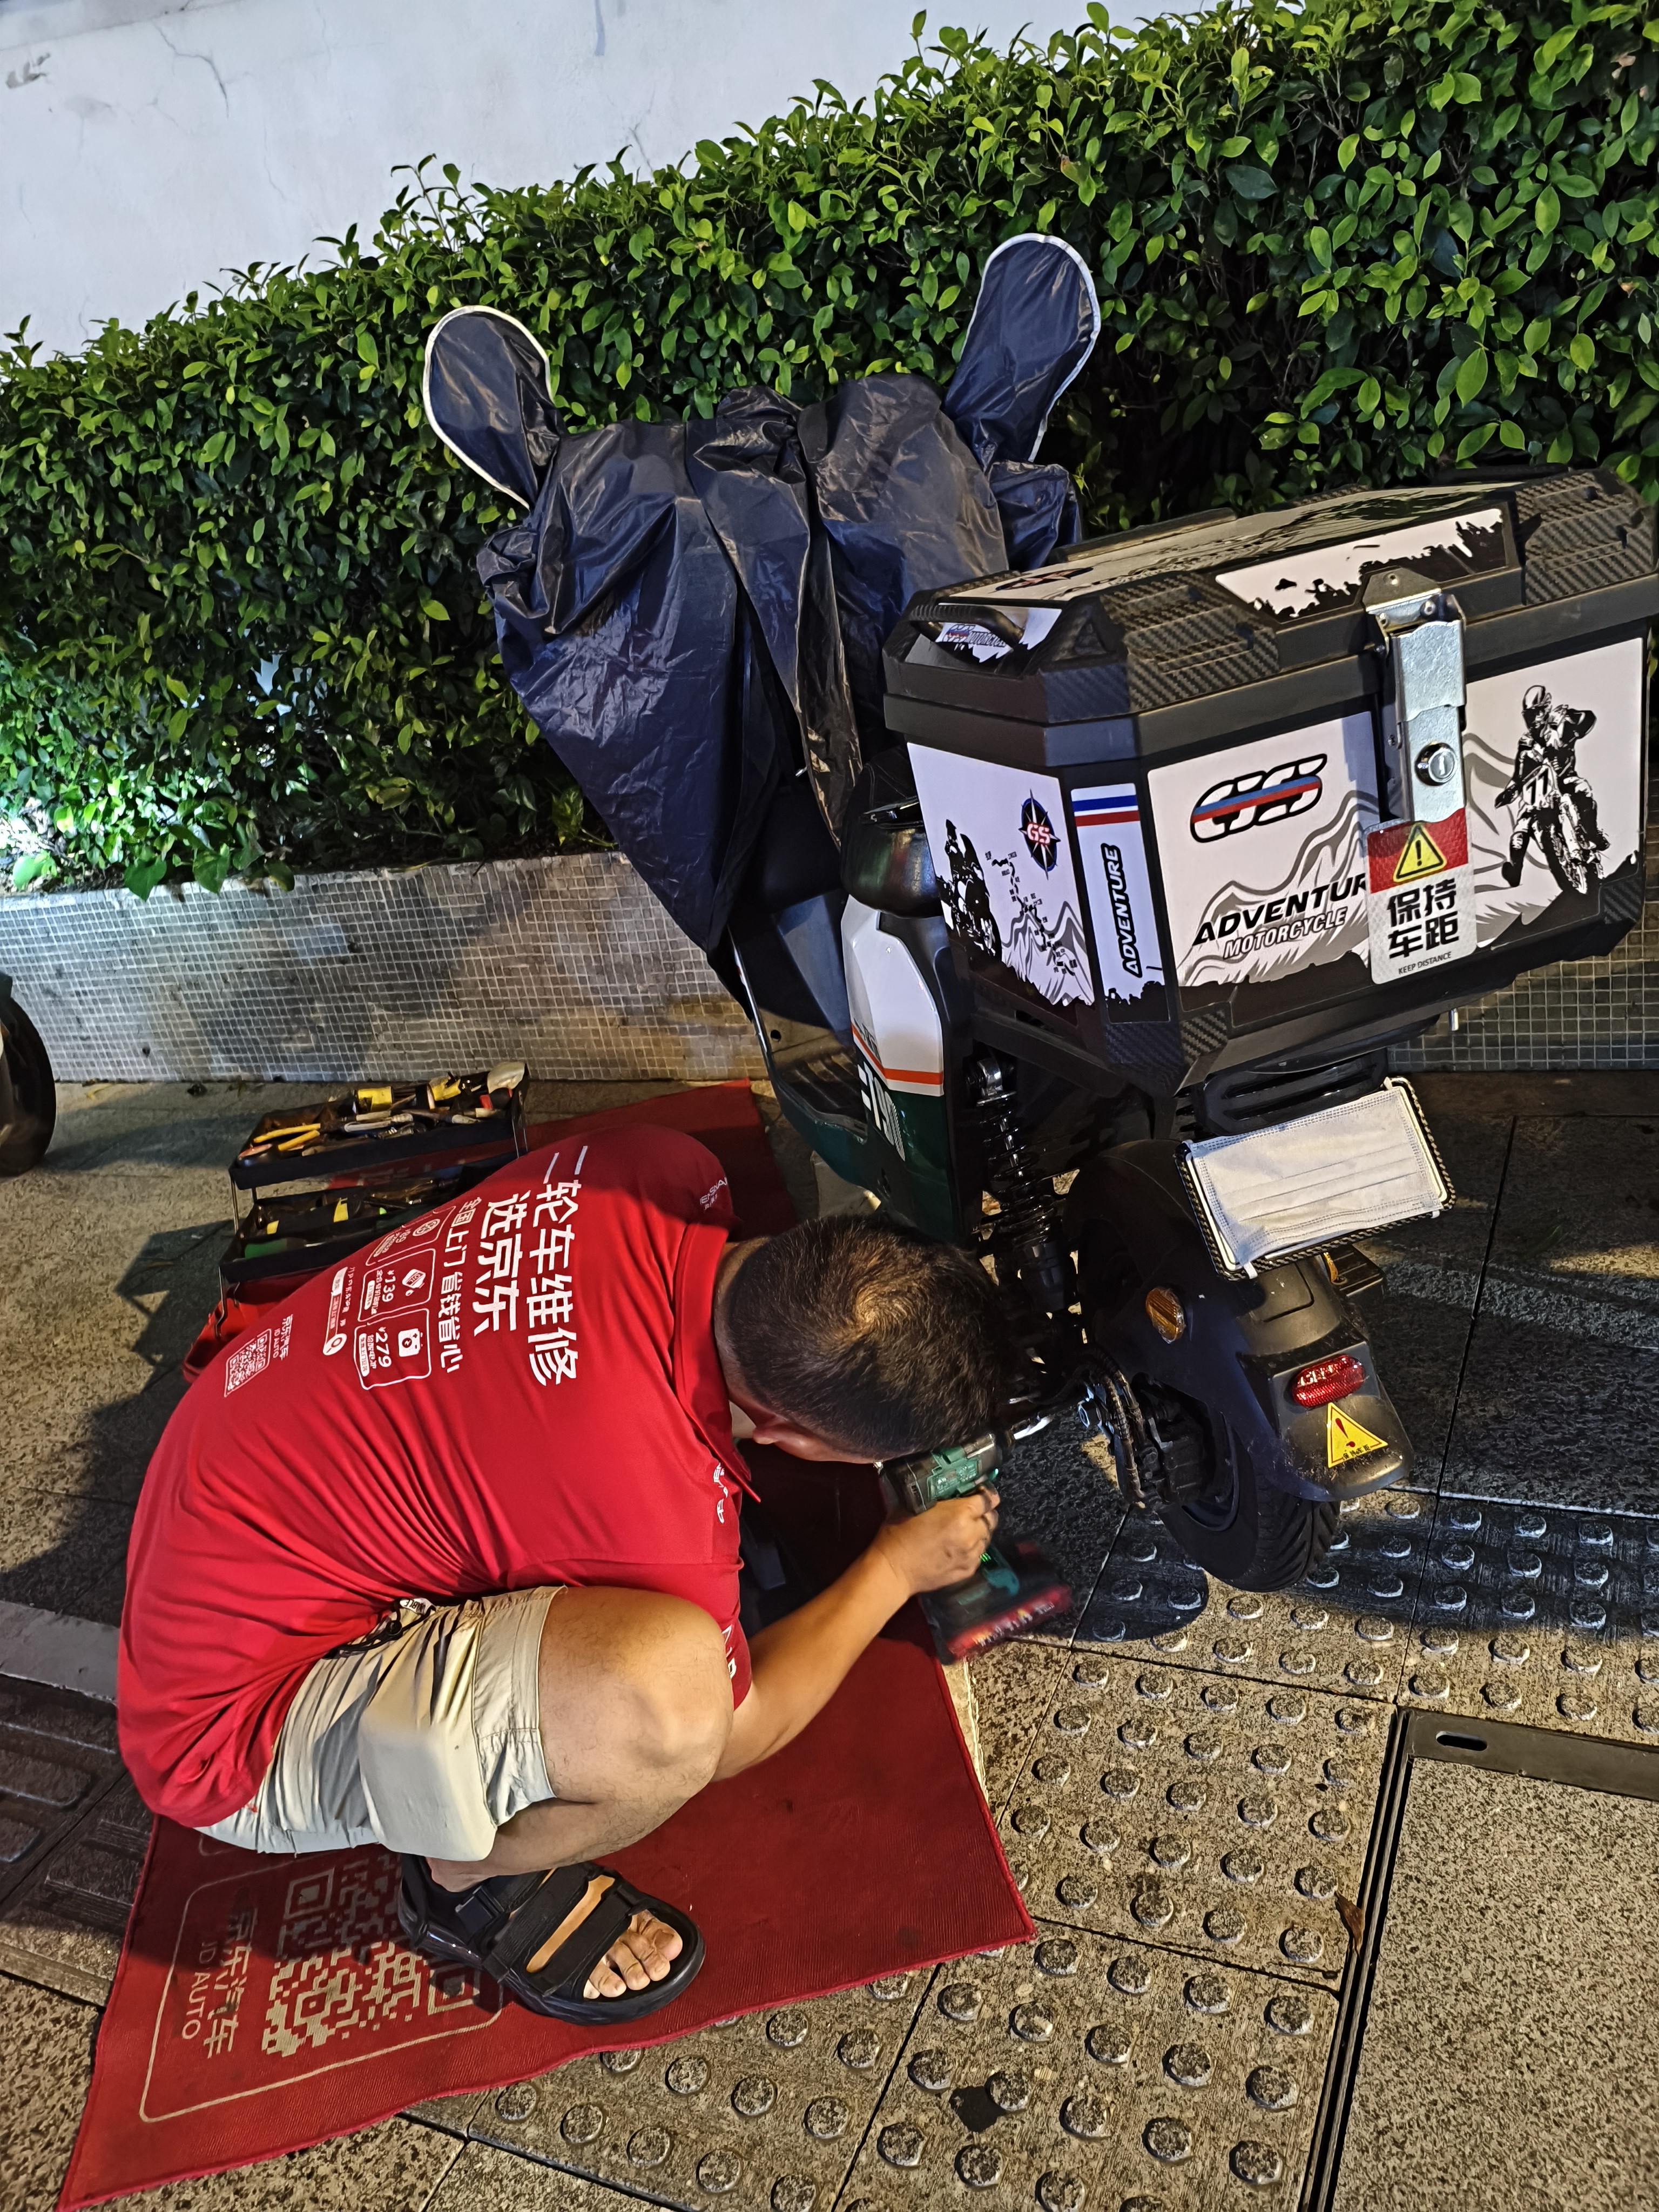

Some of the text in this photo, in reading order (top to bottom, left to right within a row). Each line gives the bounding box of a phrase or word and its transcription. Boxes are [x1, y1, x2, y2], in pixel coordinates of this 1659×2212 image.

[1027, 820, 1051, 846] GS
[1101, 843, 1143, 977] ADVENTURE
[1192, 872, 1366, 946] ADVENTUR
[1387, 878, 1457, 927] 保持
[1223, 906, 1348, 960] MOTORCYCLE
[1387, 911, 1460, 960] 车距
[1398, 951, 1452, 975] KEEP DISTANCE
[382, 1270, 396, 1302] ¥139
[437, 1197, 482, 1373] 全国上门 省钱省心
[472, 1190, 531, 1337] 选京东
[526, 1145, 588, 1386] 二轮车维修
[375, 1326, 392, 1367] ¥279
[181, 1972, 211, 2040] AUTO
